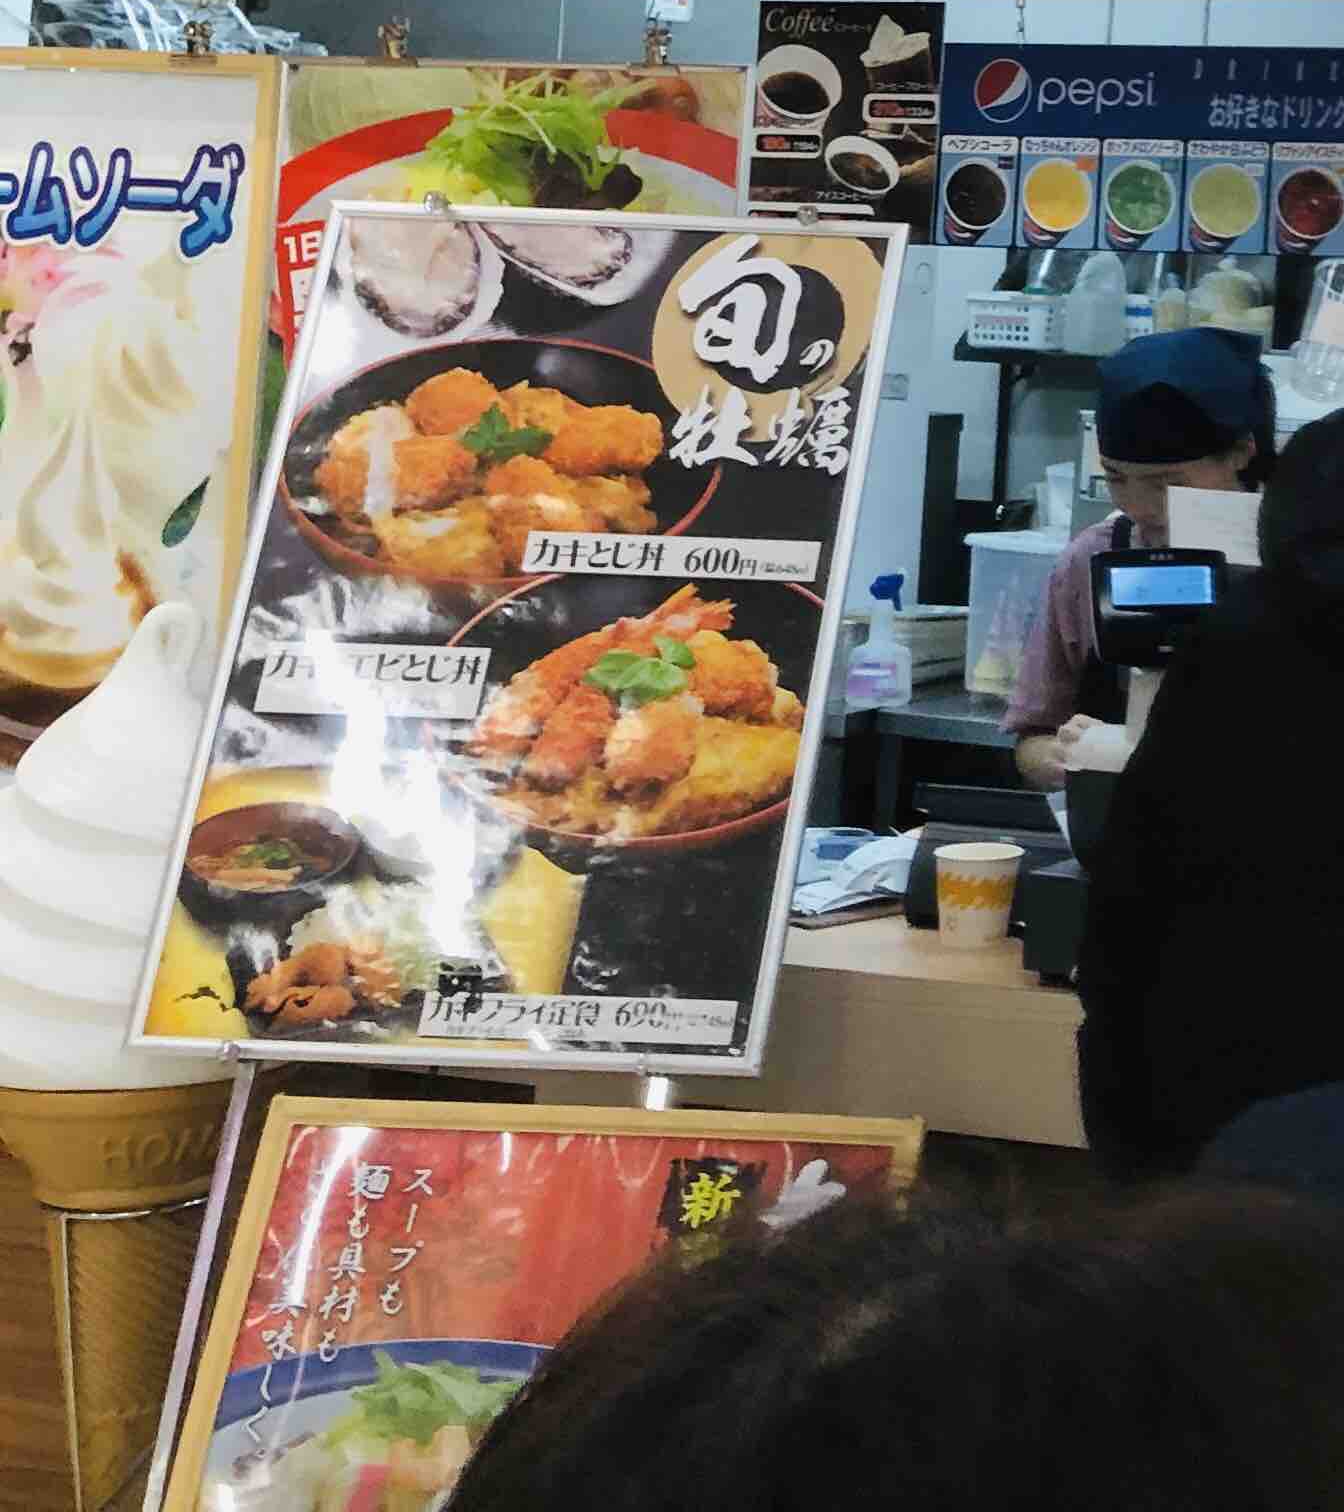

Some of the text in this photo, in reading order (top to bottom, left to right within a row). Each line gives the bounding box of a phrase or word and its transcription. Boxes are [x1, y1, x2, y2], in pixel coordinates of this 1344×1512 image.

[765, 7, 836, 38] Coffee
[1036, 71, 1157, 114] pepsi
[678, 233, 836, 383] 旬の
[668, 385, 852, 477] 牡蠣
[532, 537, 668, 572] カキとじ丼
[684, 546, 757, 577] 600円
[679, 1172, 742, 1229] 新
[319, 1160, 392, 1363] 麺も具材も
[380, 1168, 434, 1316] スープも
